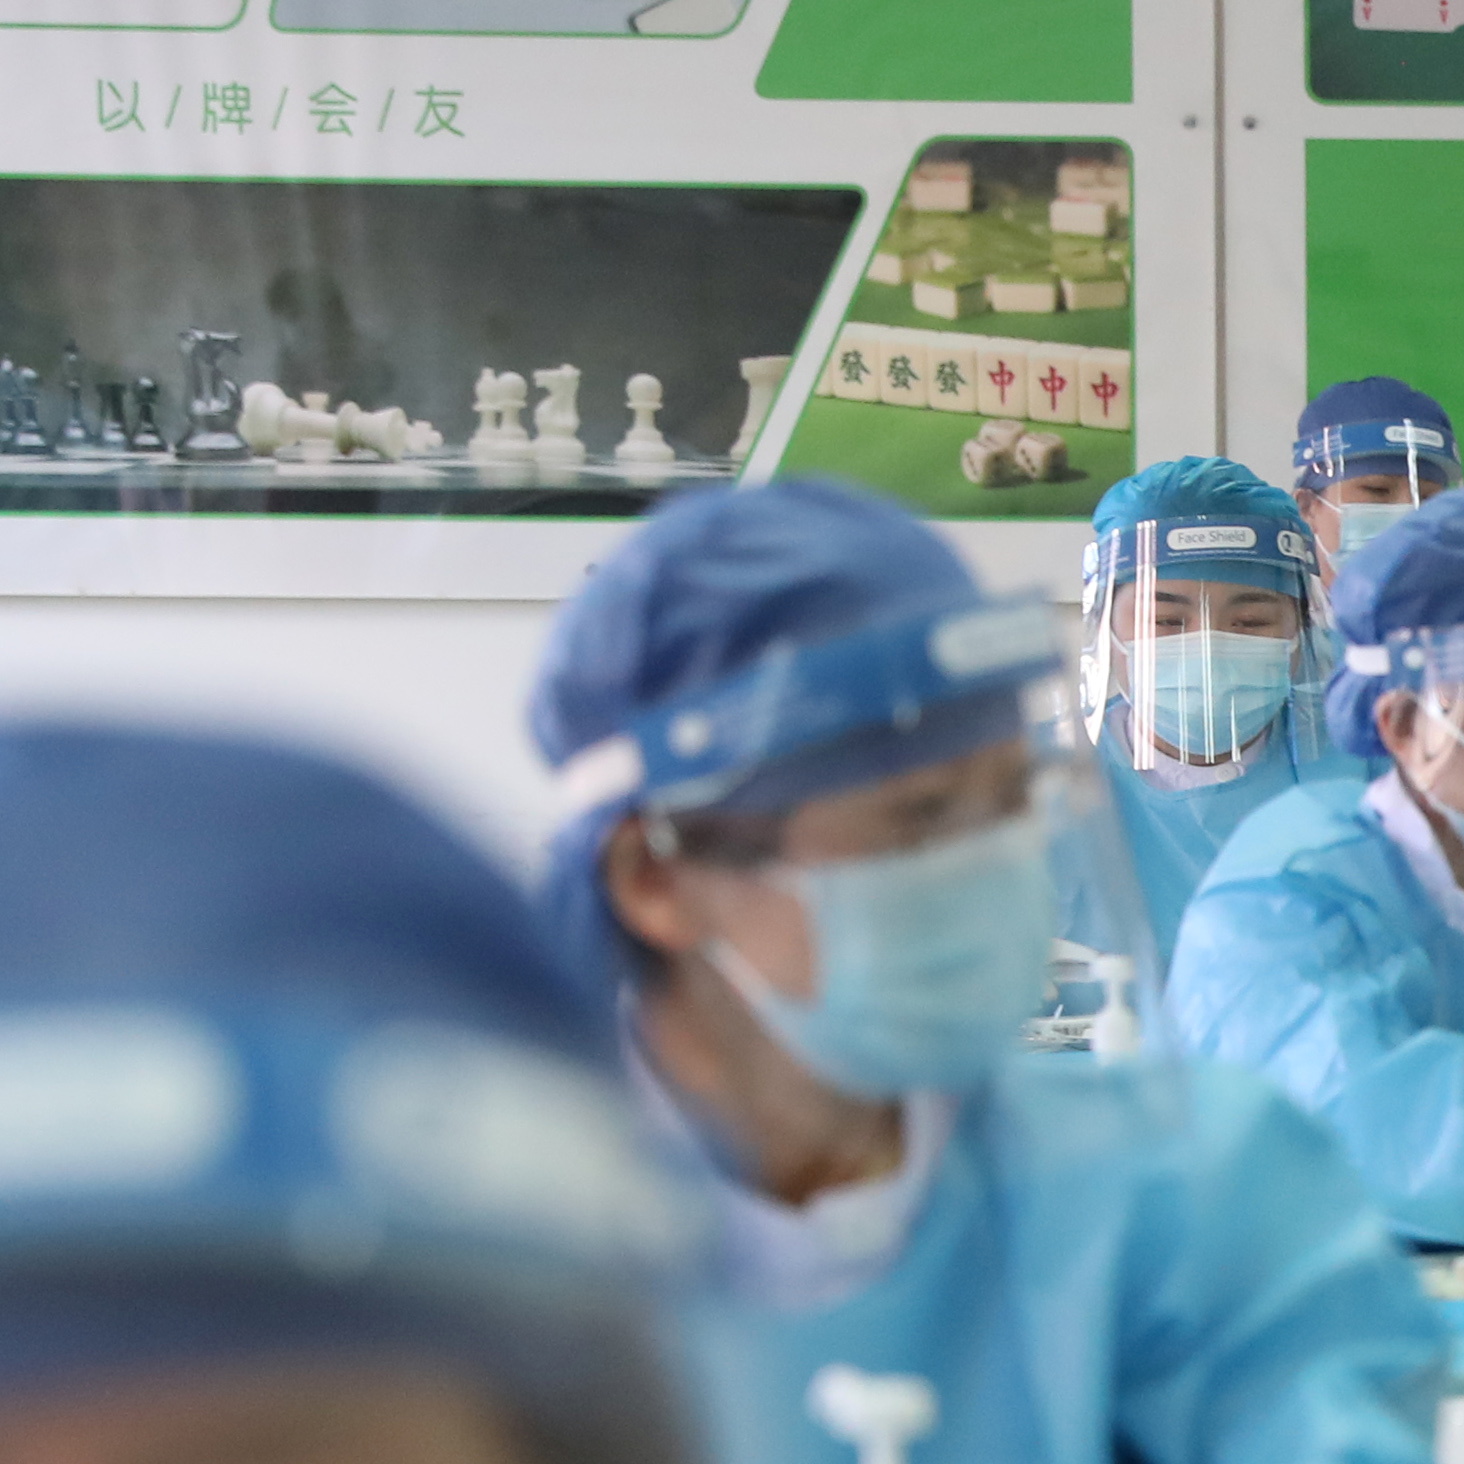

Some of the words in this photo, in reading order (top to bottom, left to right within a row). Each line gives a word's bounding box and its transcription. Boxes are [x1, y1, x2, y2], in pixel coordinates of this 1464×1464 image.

[97, 79, 466, 137] 以/牌/会/友
[1177, 532, 1206, 544] Face
[1208, 530, 1247, 542] Shield
